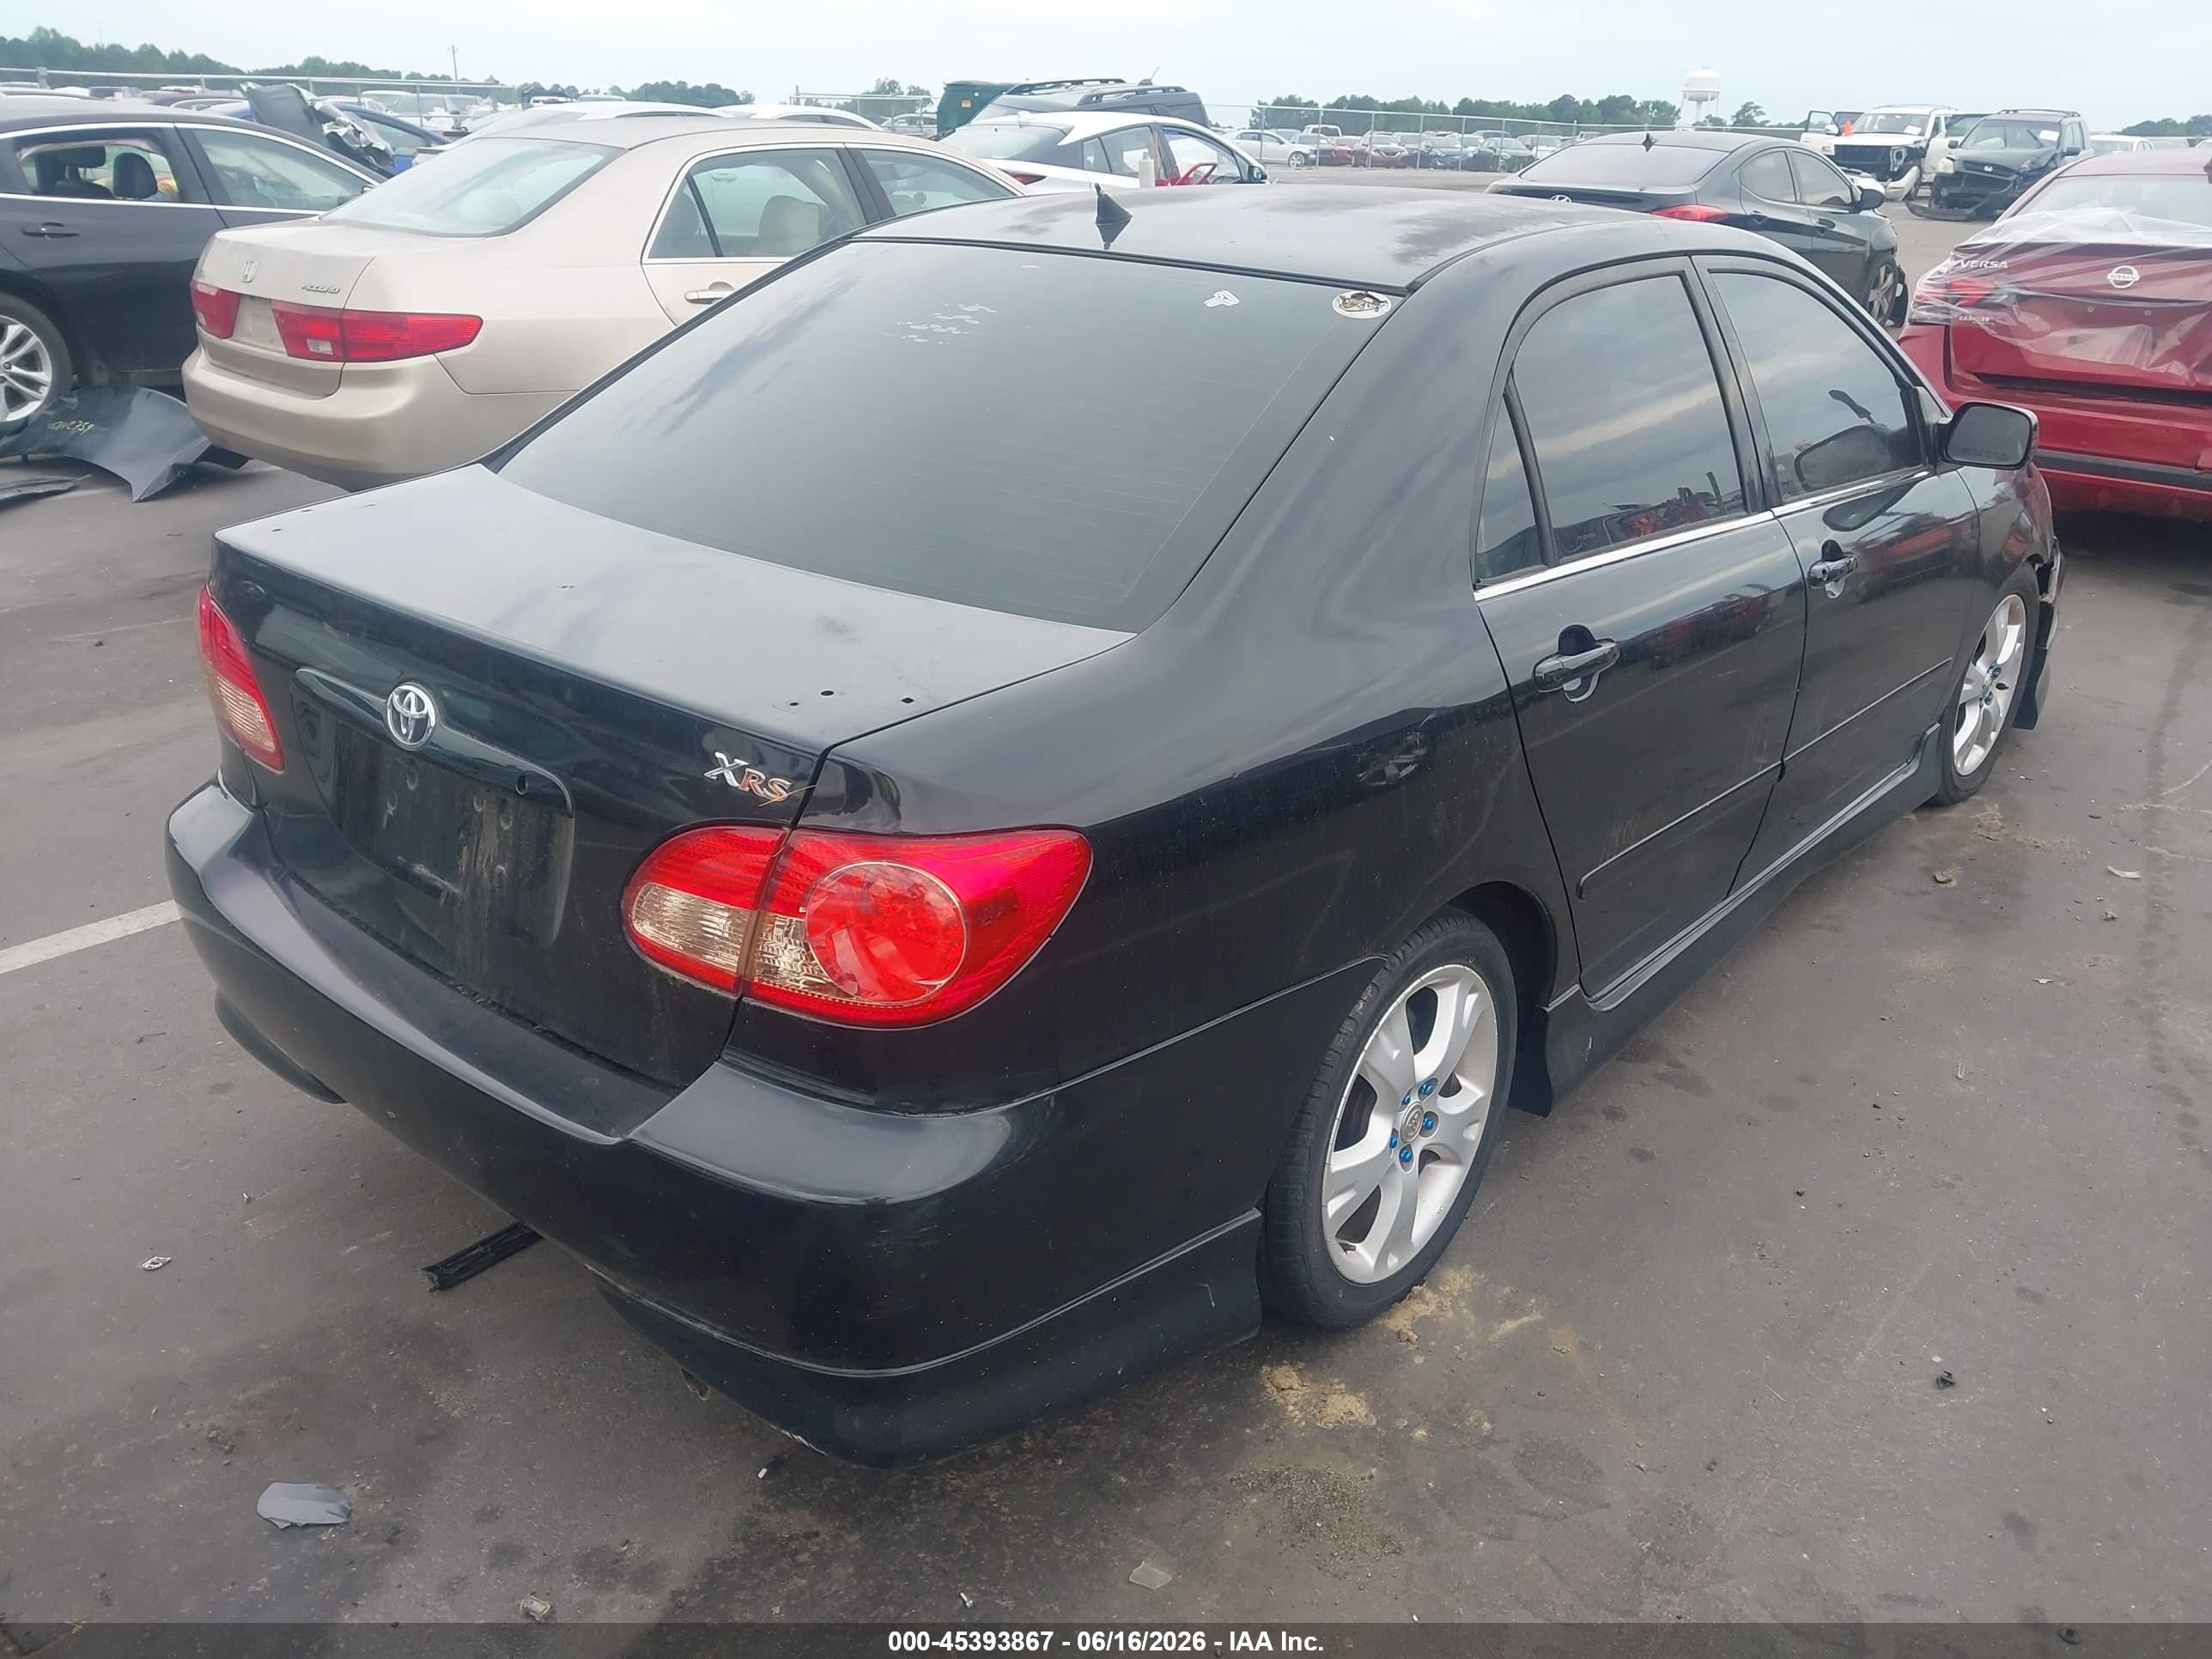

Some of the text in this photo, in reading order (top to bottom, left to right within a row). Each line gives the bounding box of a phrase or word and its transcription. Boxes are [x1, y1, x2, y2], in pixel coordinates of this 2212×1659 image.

[1960, 260, 2008, 269] VERSA
[301, 283, 341, 294] ACCORD
[704, 751, 793, 802] XRS
